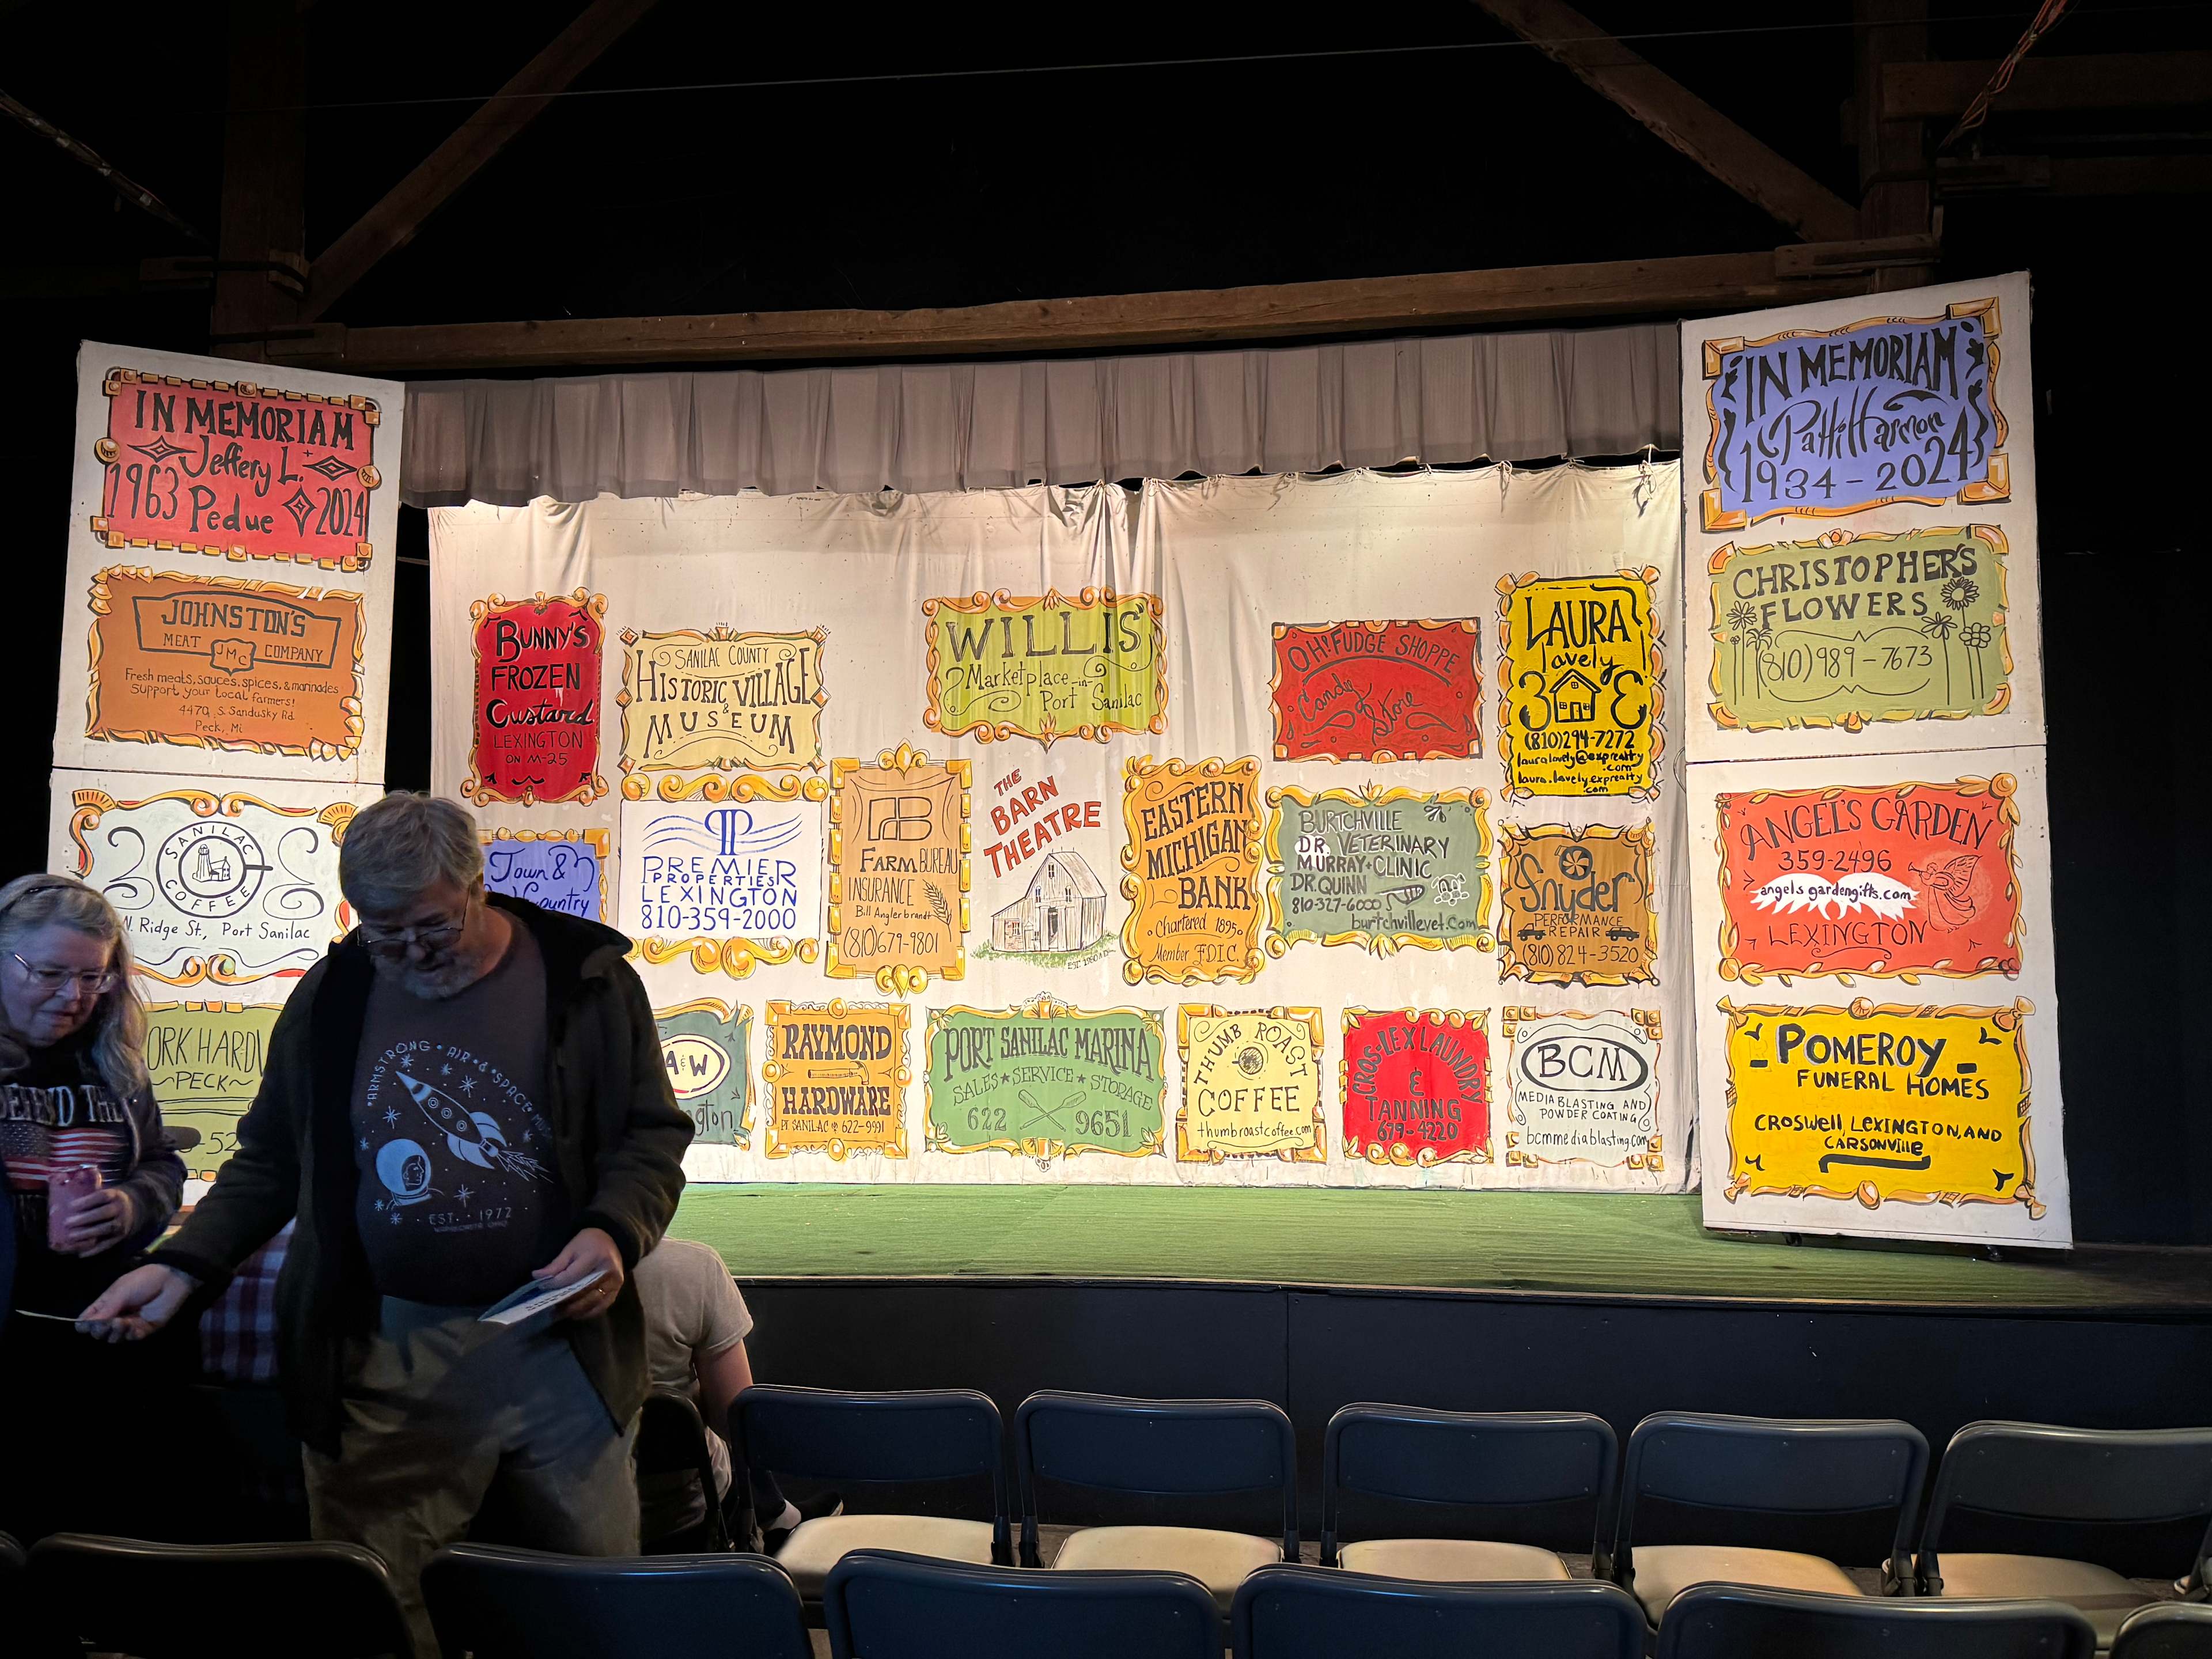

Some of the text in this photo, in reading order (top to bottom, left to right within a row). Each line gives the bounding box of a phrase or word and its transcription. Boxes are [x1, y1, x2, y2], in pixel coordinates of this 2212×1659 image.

[1744, 325, 1959, 425] IN MEMORIAM
[135, 391, 354, 450] IN MEMORIAM
[180, 435, 304, 497] Jeffery L.
[1740, 406, 1975, 503] 1934 2024
[107, 463, 180, 519] 1963
[188, 485, 273, 533] Pedue
[1733, 543, 1978, 600] CHRISTOPHER'S
[162, 599, 306, 637] JOHNSTON'S
[1525, 597, 1632, 650] LAURA
[1760, 591, 1929, 630] FLOWERS
[162, 633, 323, 662] MEAT COMPANY
[675, 645, 769, 669] SANILAC COUNTY
[1395, 634, 1460, 674] SHOPPE
[126, 668, 153, 681] Fresh
[292, 682, 339, 694] marinades
[491, 662, 580, 691] FROZEN
[635, 647, 811, 708] HISTORIC VILLAGE
[965, 661, 1069, 696] Marketplace
[130, 684, 179, 698] Support
[183, 687, 210, 700] your
[252, 692, 295, 707] farmers!
[1040, 683, 1142, 711] Port Sanilac
[230, 706, 277, 721] Sandusky
[231, 724, 243, 733] Mi
[494, 730, 582, 749] LEXINGTON
[643, 710, 795, 759] MUSEUM
[1524, 730, 1635, 750] (810)294-7272
[505, 752, 568, 766] ON M-25
[994, 768, 1021, 796] THE
[990, 775, 1059, 835] BARN
[1141, 781, 1244, 842] EASTERN
[1299, 810, 1403, 834] BURTCHVILLE
[1740, 797, 1993, 862] ANGEL'S GARDEN
[164, 825, 255, 859] SANILAC
[983, 801, 1101, 878] THEATRE
[1146, 819, 1248, 880] MICHIGAN
[1337, 834, 1449, 859] VETERINARY
[642, 857, 797, 888] PREMIER
[860, 847, 958, 874] FARM BUREAU
[1297, 854, 1431, 879] MURRAY CLINIC
[1778, 849, 1892, 872] 359-2496
[653, 873, 775, 887] PROPERTIES
[849, 877, 915, 906] INSURANCE
[1178, 876, 1251, 910] BANK
[1290, 873, 1367, 895] DR. QUINN
[1515, 853, 1635, 922] Snyder
[164, 879, 251, 913] COFFEE
[642, 885, 797, 907] LEXINGTON
[856, 905, 870, 917] Bill
[1292, 897, 1382, 914] 810-327-6000
[140, 918, 178, 941] Ridge
[222, 922, 252, 937] Port
[259, 921, 309, 940] Sanilac
[642, 905, 796, 931] 810-359-2000
[1156, 912, 1237, 938] Chartered 1895
[1535, 914, 1623, 927] PERFORMANCE
[1550, 926, 1600, 937] REPAIR
[1768, 921, 1927, 947] LEXINGTON
[1148, 942, 1190, 963] Member
[147, 1027, 192, 1070] ORK
[781, 1024, 892, 1061] RAYMOND
[944, 1025, 1155, 1083] PORT SANILAC MARINA
[1194, 1021, 1308, 1085] THUMB ROAST
[1775, 1024, 1946, 1077] POMEROY
[369, 1041, 431, 1101] ARMSTRONG
[447, 1046, 470, 1062] AIR
[1419, 1027, 1483, 1104] LAUNDRY
[1538, 1043, 1627, 1081] BCM
[176, 1071, 229, 1092] PECK
[952, 1066, 1153, 1111] SALES SERVICE STORAGE
[1797, 1069, 1988, 1100] FUNERAL HOMES
[782, 1086, 891, 1117] HARDWARE
[1198, 1085, 1300, 1118] COFFEE
[1368, 1099, 1461, 1122] TANNING
[1518, 1090, 1646, 1111] MEDIA BLASTING AND
[1540, 1108, 1636, 1123] POWDER COATING
[791, 1119, 884, 1134] SANILAC 622-9991
[967, 1107, 1132, 1138] 622 9651
[1377, 1120, 1458, 1142] 679-4220
